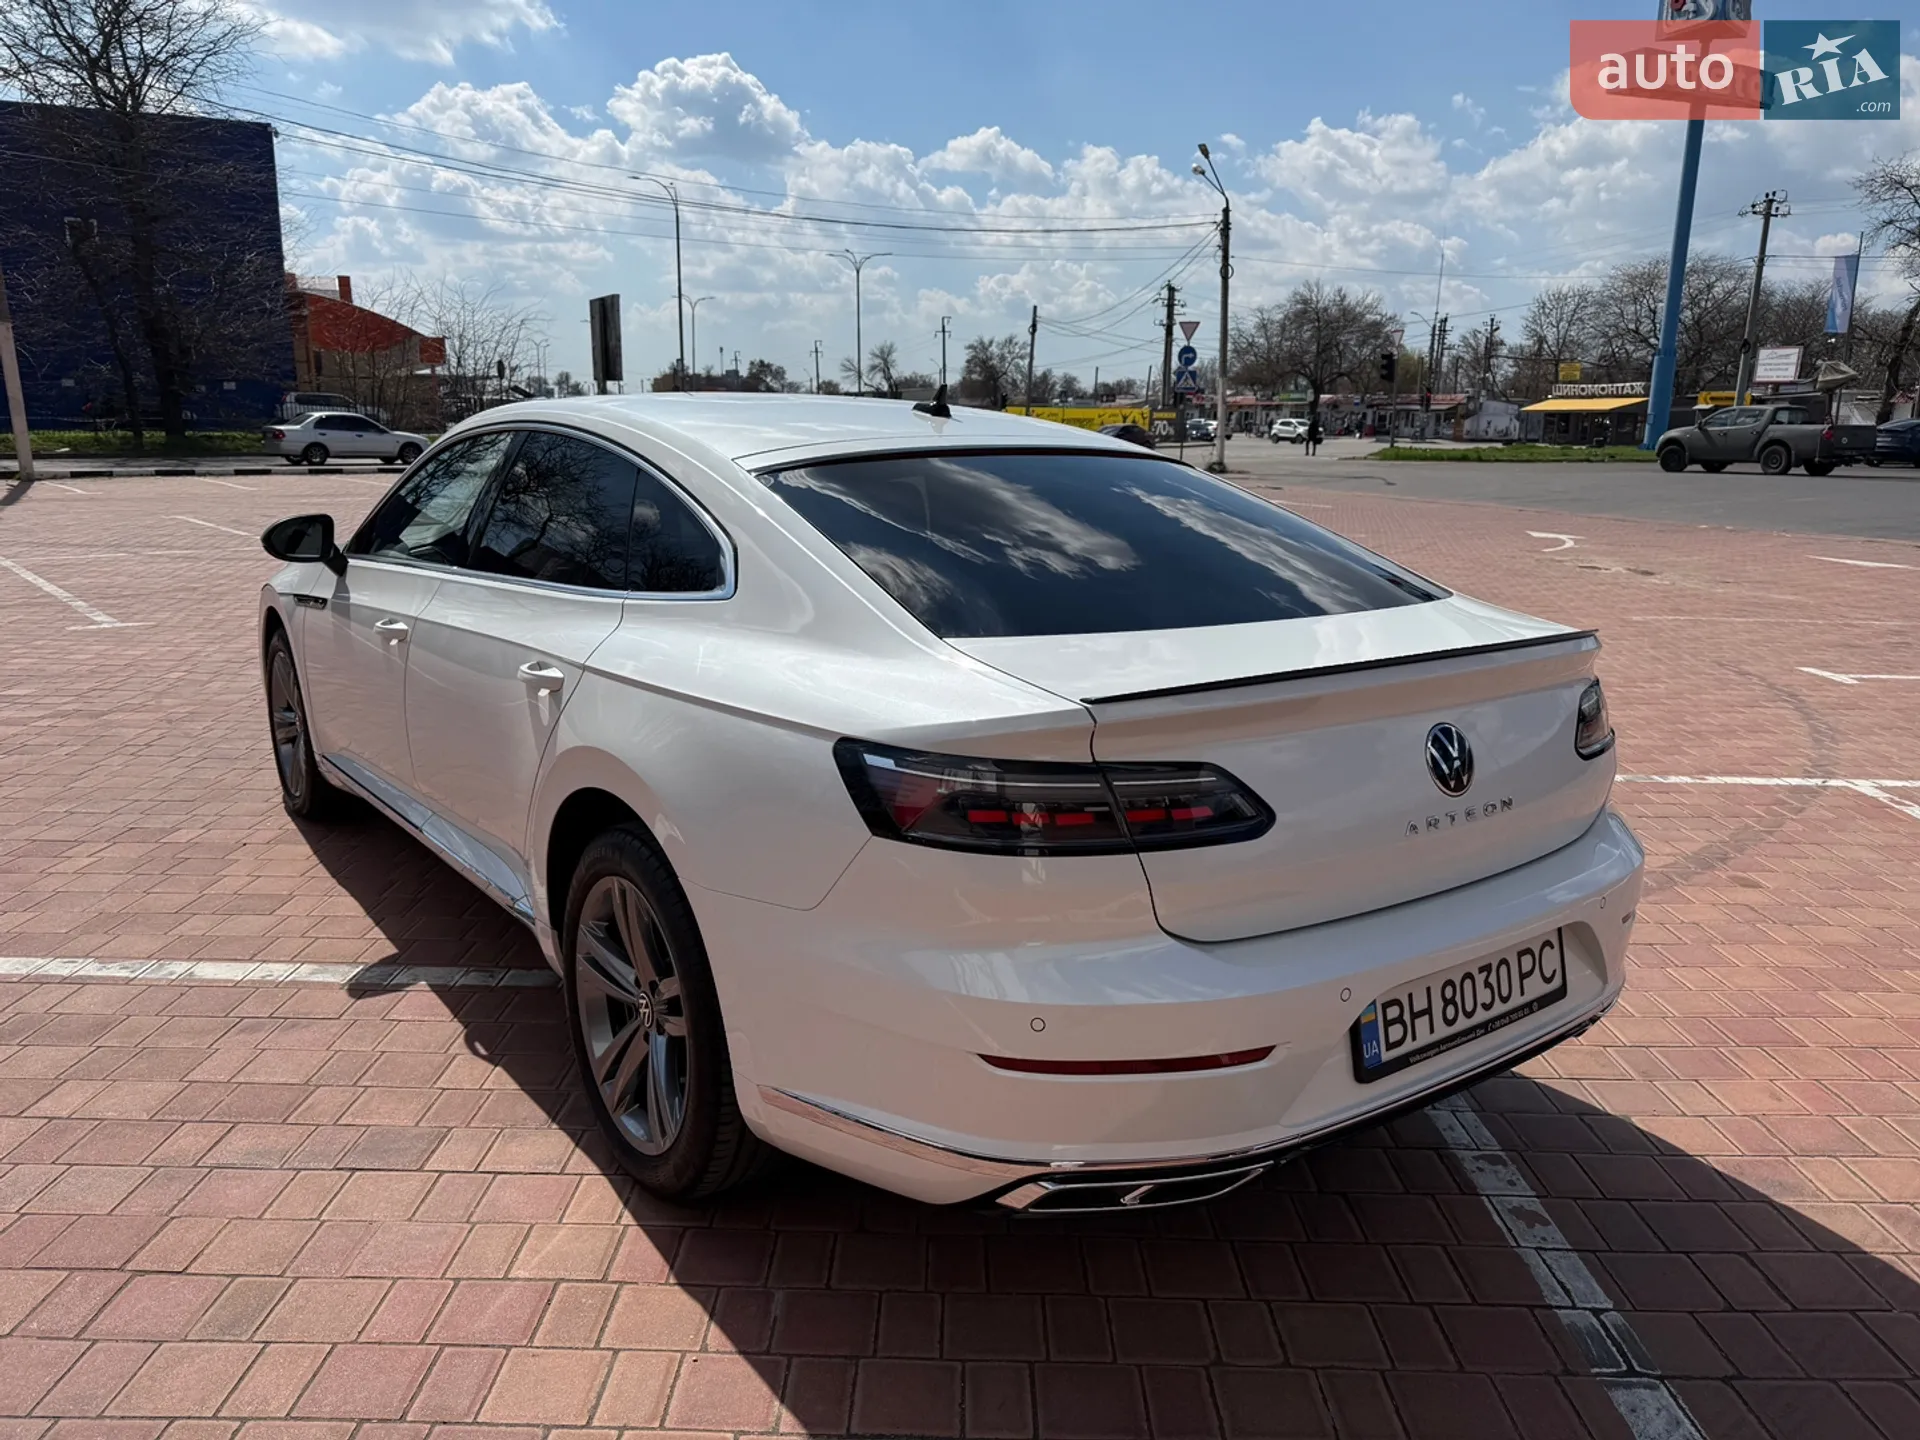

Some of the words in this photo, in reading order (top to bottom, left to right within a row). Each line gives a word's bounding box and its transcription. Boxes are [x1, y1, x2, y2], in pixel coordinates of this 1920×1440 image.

[1552, 382, 1646, 396] ШИНОМОНТАЖ
[1404, 796, 1513, 837] ARTEON
[1440, 957, 1513, 1027] 8030
[1363, 1042, 1380, 1059] UA
